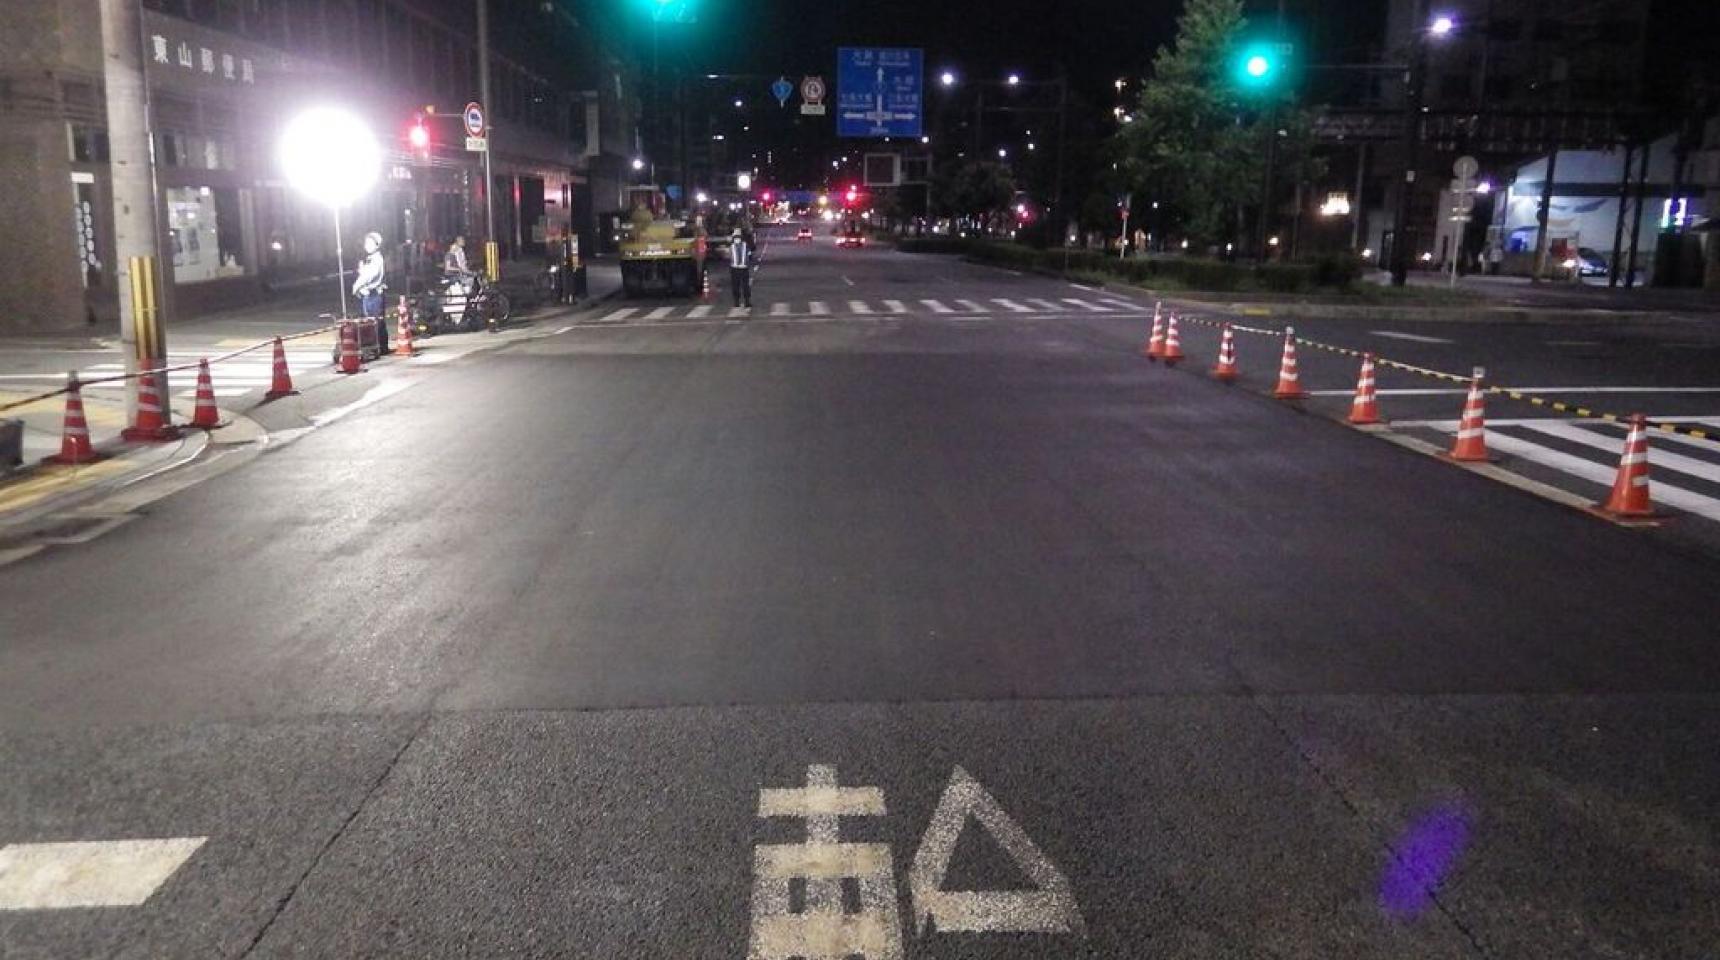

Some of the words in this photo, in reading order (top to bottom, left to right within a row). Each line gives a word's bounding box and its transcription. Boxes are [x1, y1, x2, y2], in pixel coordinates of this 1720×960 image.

[152, 34, 255, 85] 東山郵便局
